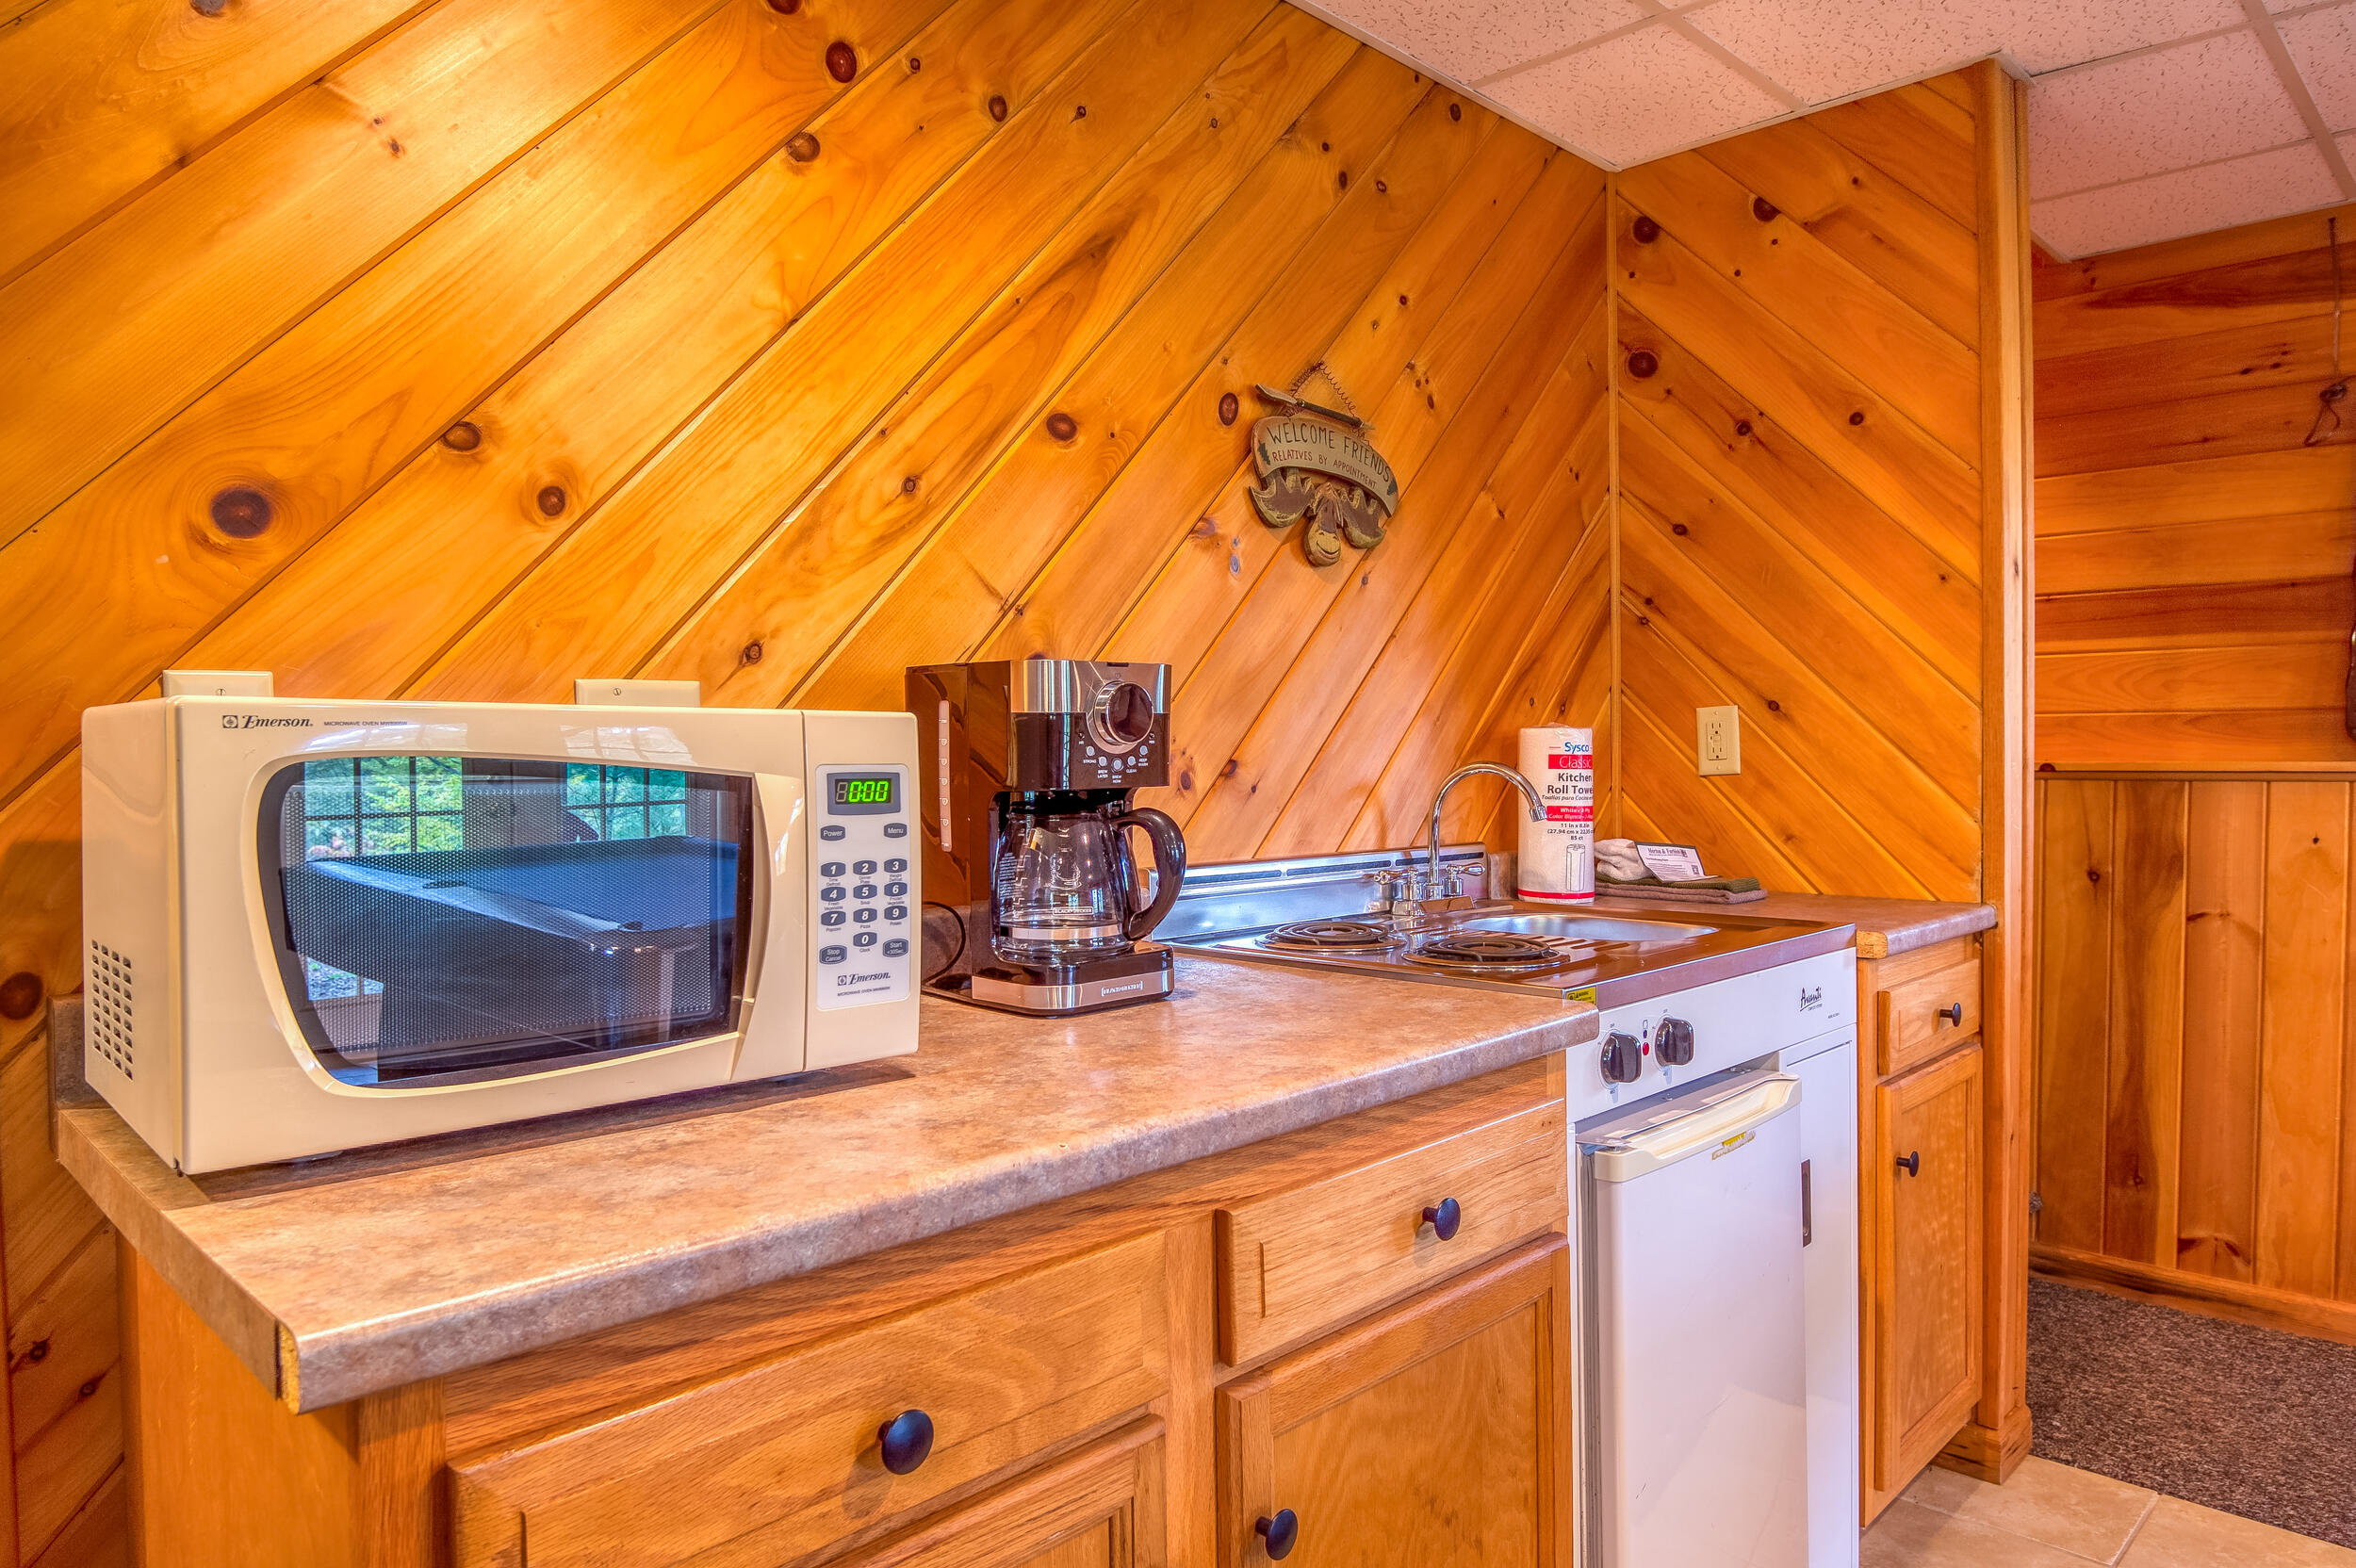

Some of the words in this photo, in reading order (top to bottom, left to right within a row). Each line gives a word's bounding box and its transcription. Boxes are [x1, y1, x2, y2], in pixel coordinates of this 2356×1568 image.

[1267, 422, 1335, 449] WELCOME
[1343, 436, 1390, 482] FRIENDS
[1272, 449, 1313, 462] RELATIVES
[1319, 454, 1328, 466] BY
[1333, 459, 1377, 489] APPOINTMENT
[1564, 742, 1590, 754] Sysco
[1559, 755, 1592, 768] Classic
[1558, 773, 1593, 782] Kitchen
[848, 780, 889, 803] 0:00
[1547, 785, 1569, 794] Roll
[1571, 785, 1594, 794] Towe
[830, 865, 837, 874] 1
[861, 863, 869, 873] 2
[892, 861, 899, 870] 3
[829, 889, 838, 899] 4
[861, 887, 869, 896] 5
[892, 884, 899, 894] 6
[861, 910, 869, 921] 8
[892, 907, 899, 918] 9
[830, 913, 838, 923] 7
[861, 934, 869, 944] 0
